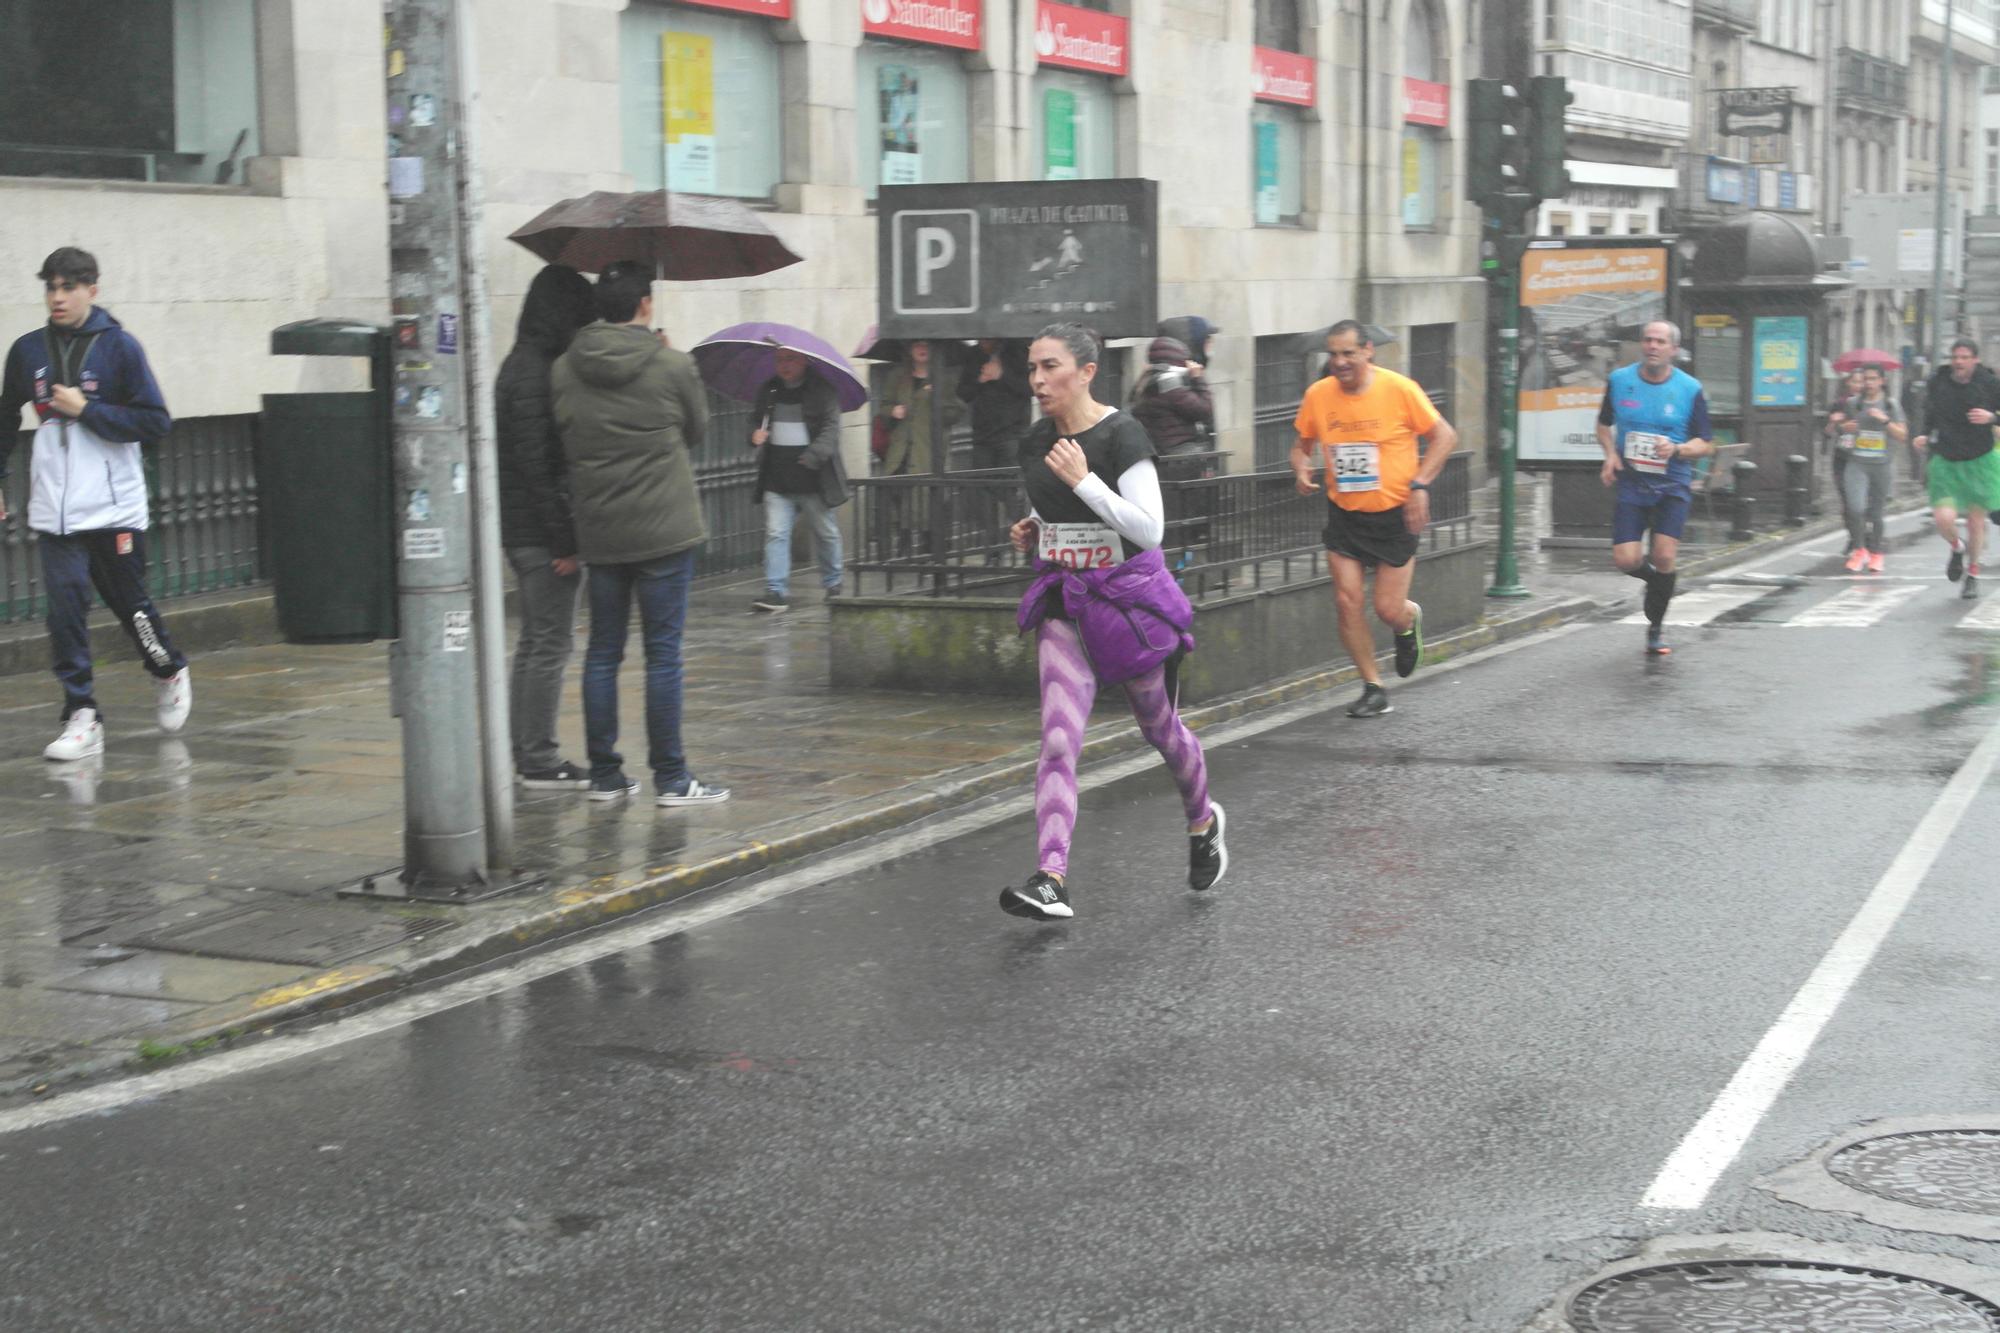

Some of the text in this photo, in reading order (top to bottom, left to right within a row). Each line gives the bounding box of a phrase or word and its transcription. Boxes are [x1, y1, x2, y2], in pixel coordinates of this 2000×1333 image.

[889, 0, 977, 37] Santander
[1055, 22, 1124, 67] Santander
[916, 227, 956, 295] P
